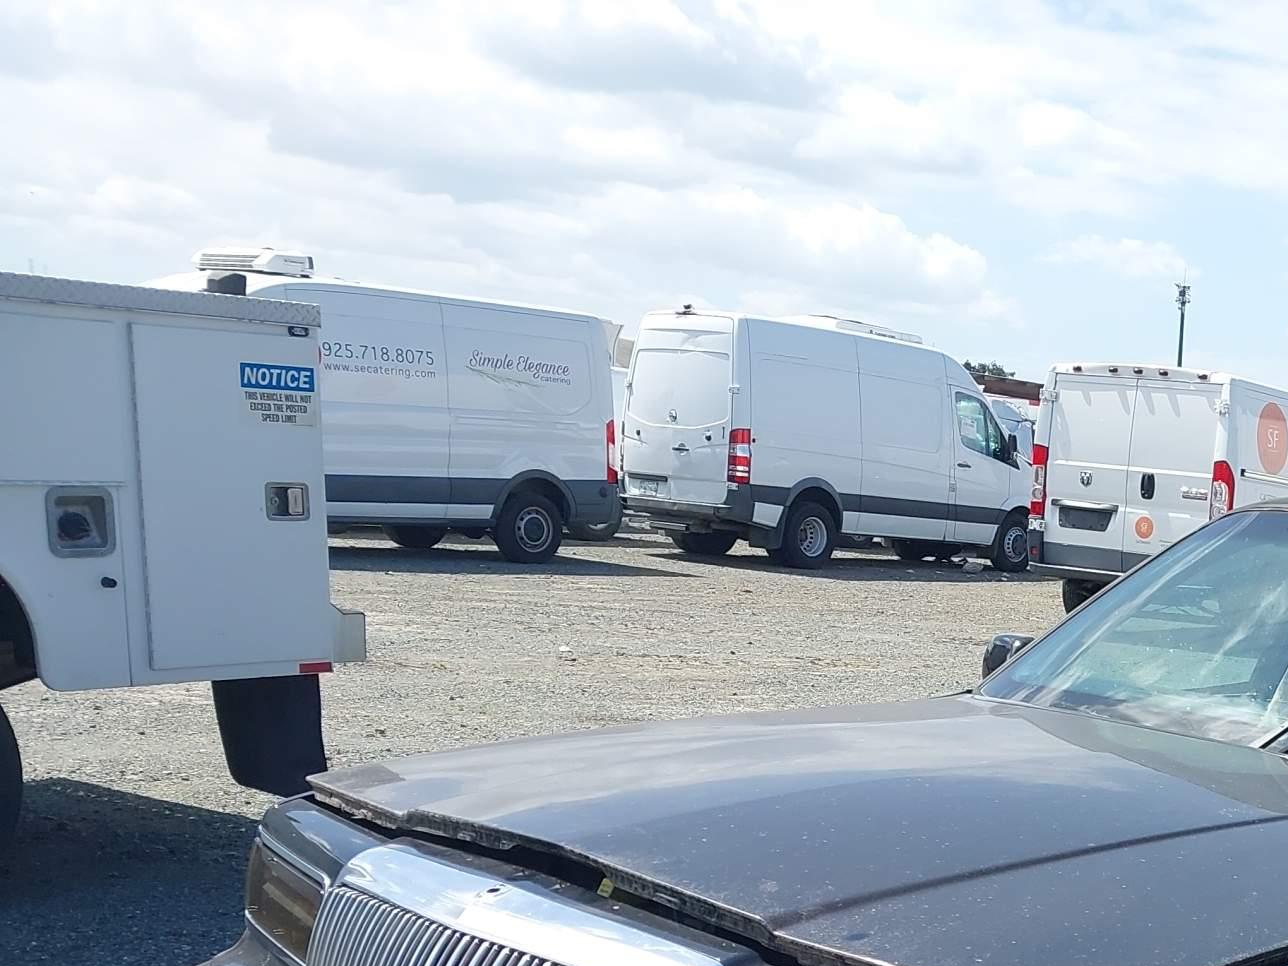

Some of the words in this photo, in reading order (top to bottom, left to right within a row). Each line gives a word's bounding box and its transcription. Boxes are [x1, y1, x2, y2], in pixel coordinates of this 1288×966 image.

[322, 341, 434, 366] 925.718.8075
[323, 363, 436, 378] www.secatering.com
[469, 349, 514, 372] Simple
[516, 356, 570, 379] Elegance
[243, 367, 311, 388] NOTICE
[540, 376, 571, 385] catering
[244, 391, 258, 401] THIS
[259, 392, 283, 402] VEHICLE
[284, 394, 299, 403] WILL
[300, 395, 312, 404] NOT
[250, 402, 272, 411] EXCEED
[273, 403, 284, 412] THE
[285, 404, 308, 413] POSTED
[261, 413, 280, 422] SPEED
[281, 415, 297, 423] LIMIT
[1267, 429, 1280, 449] SF
